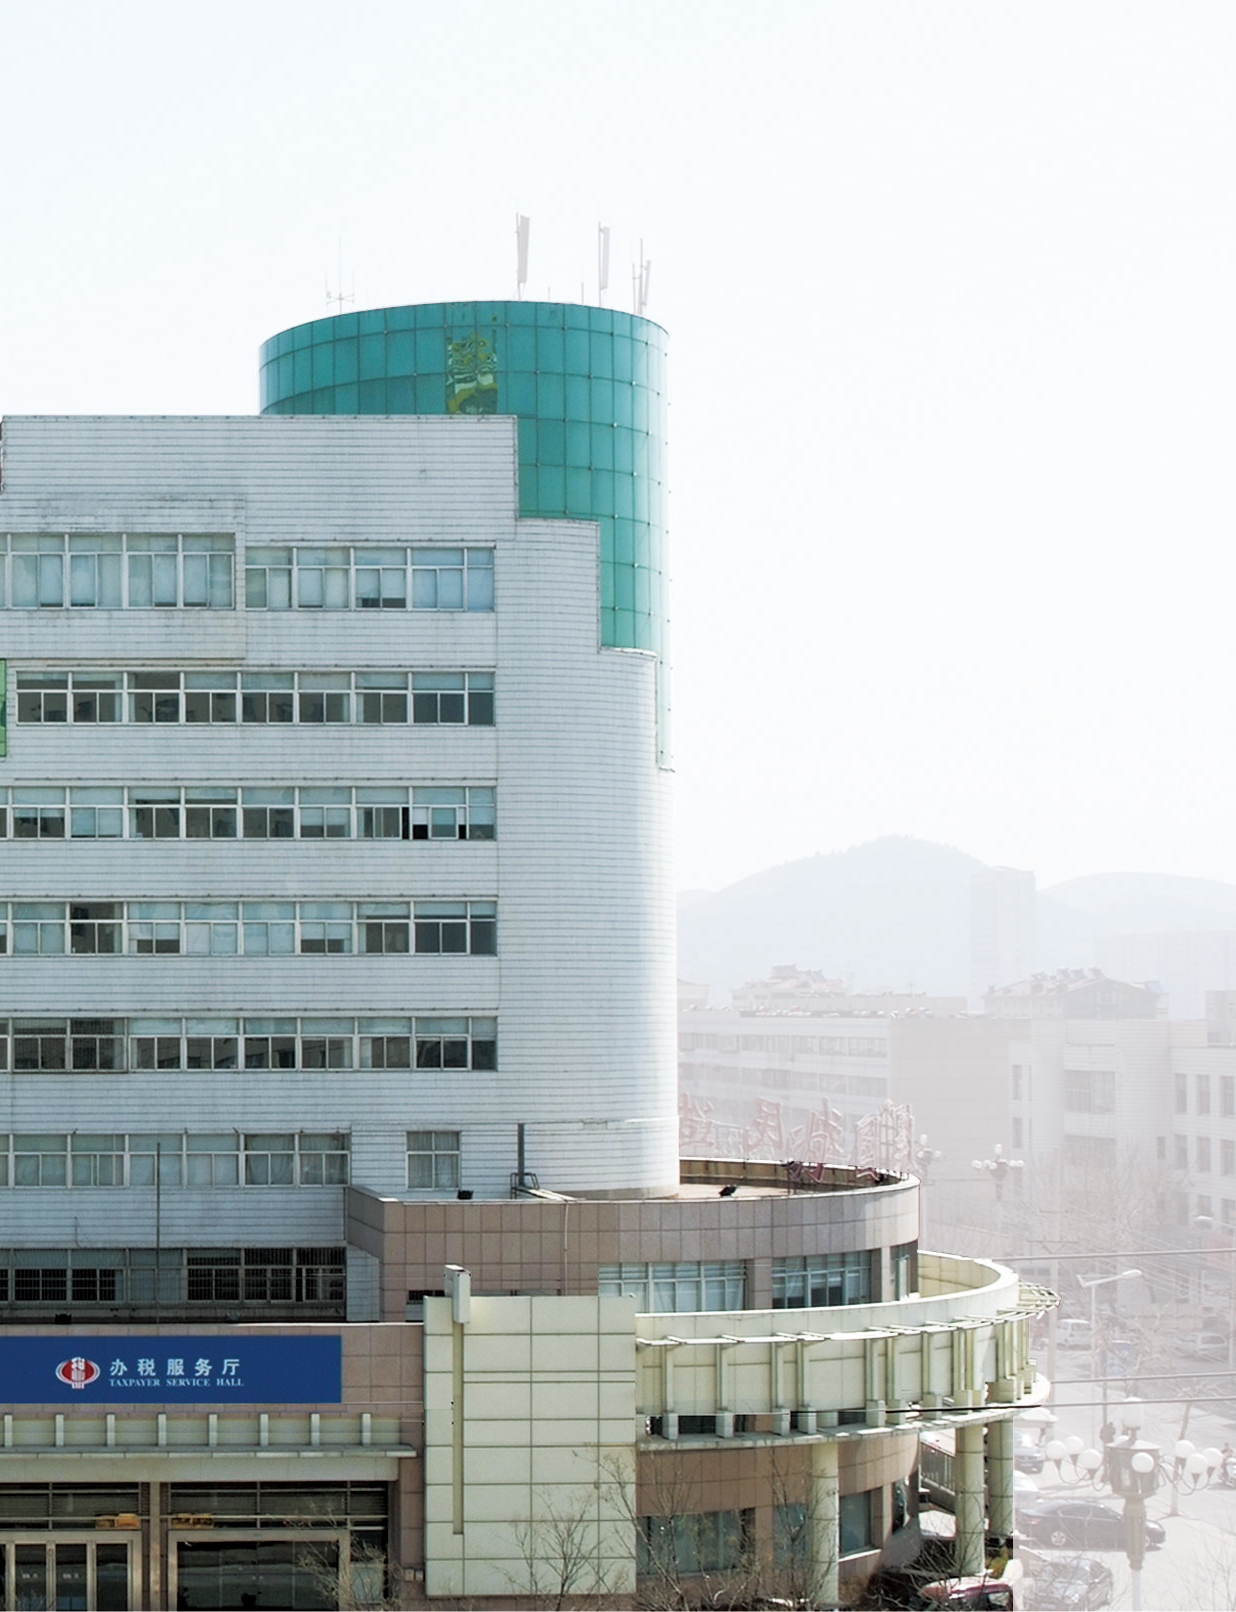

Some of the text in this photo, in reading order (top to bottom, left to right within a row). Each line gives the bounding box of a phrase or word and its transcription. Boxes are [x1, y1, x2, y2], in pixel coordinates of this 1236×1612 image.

[110, 1358, 240, 1376] 办税服务厅
[109, 1378, 244, 1387] TAXPAYER SERVICE HALL
